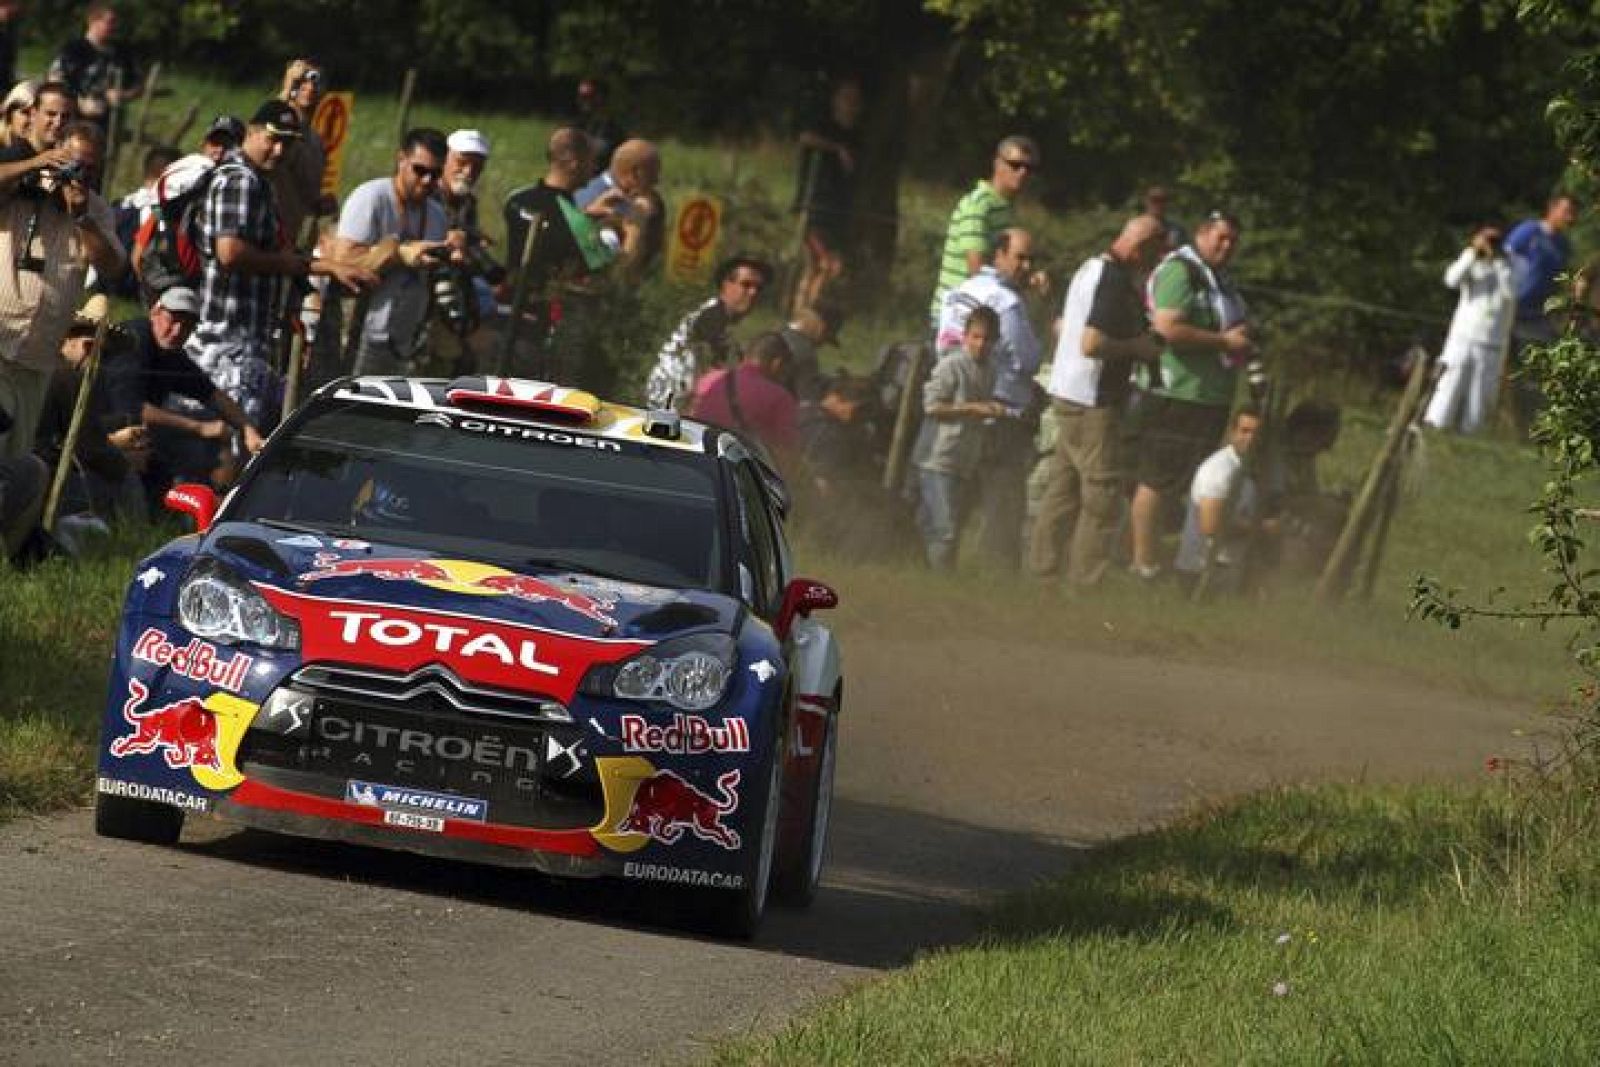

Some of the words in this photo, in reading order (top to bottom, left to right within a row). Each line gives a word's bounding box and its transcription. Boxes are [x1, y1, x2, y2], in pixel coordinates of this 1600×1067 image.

[131, 626, 200, 676] Red
[188, 641, 253, 692] Bull
[329, 610, 559, 677] TOTAL
[621, 714, 685, 754] Red
[686, 715, 751, 752] Bull
[99, 777, 208, 812] EURODATACAR
[381, 790, 481, 816] MICHELIN
[623, 861, 743, 889] EURODATACAR
